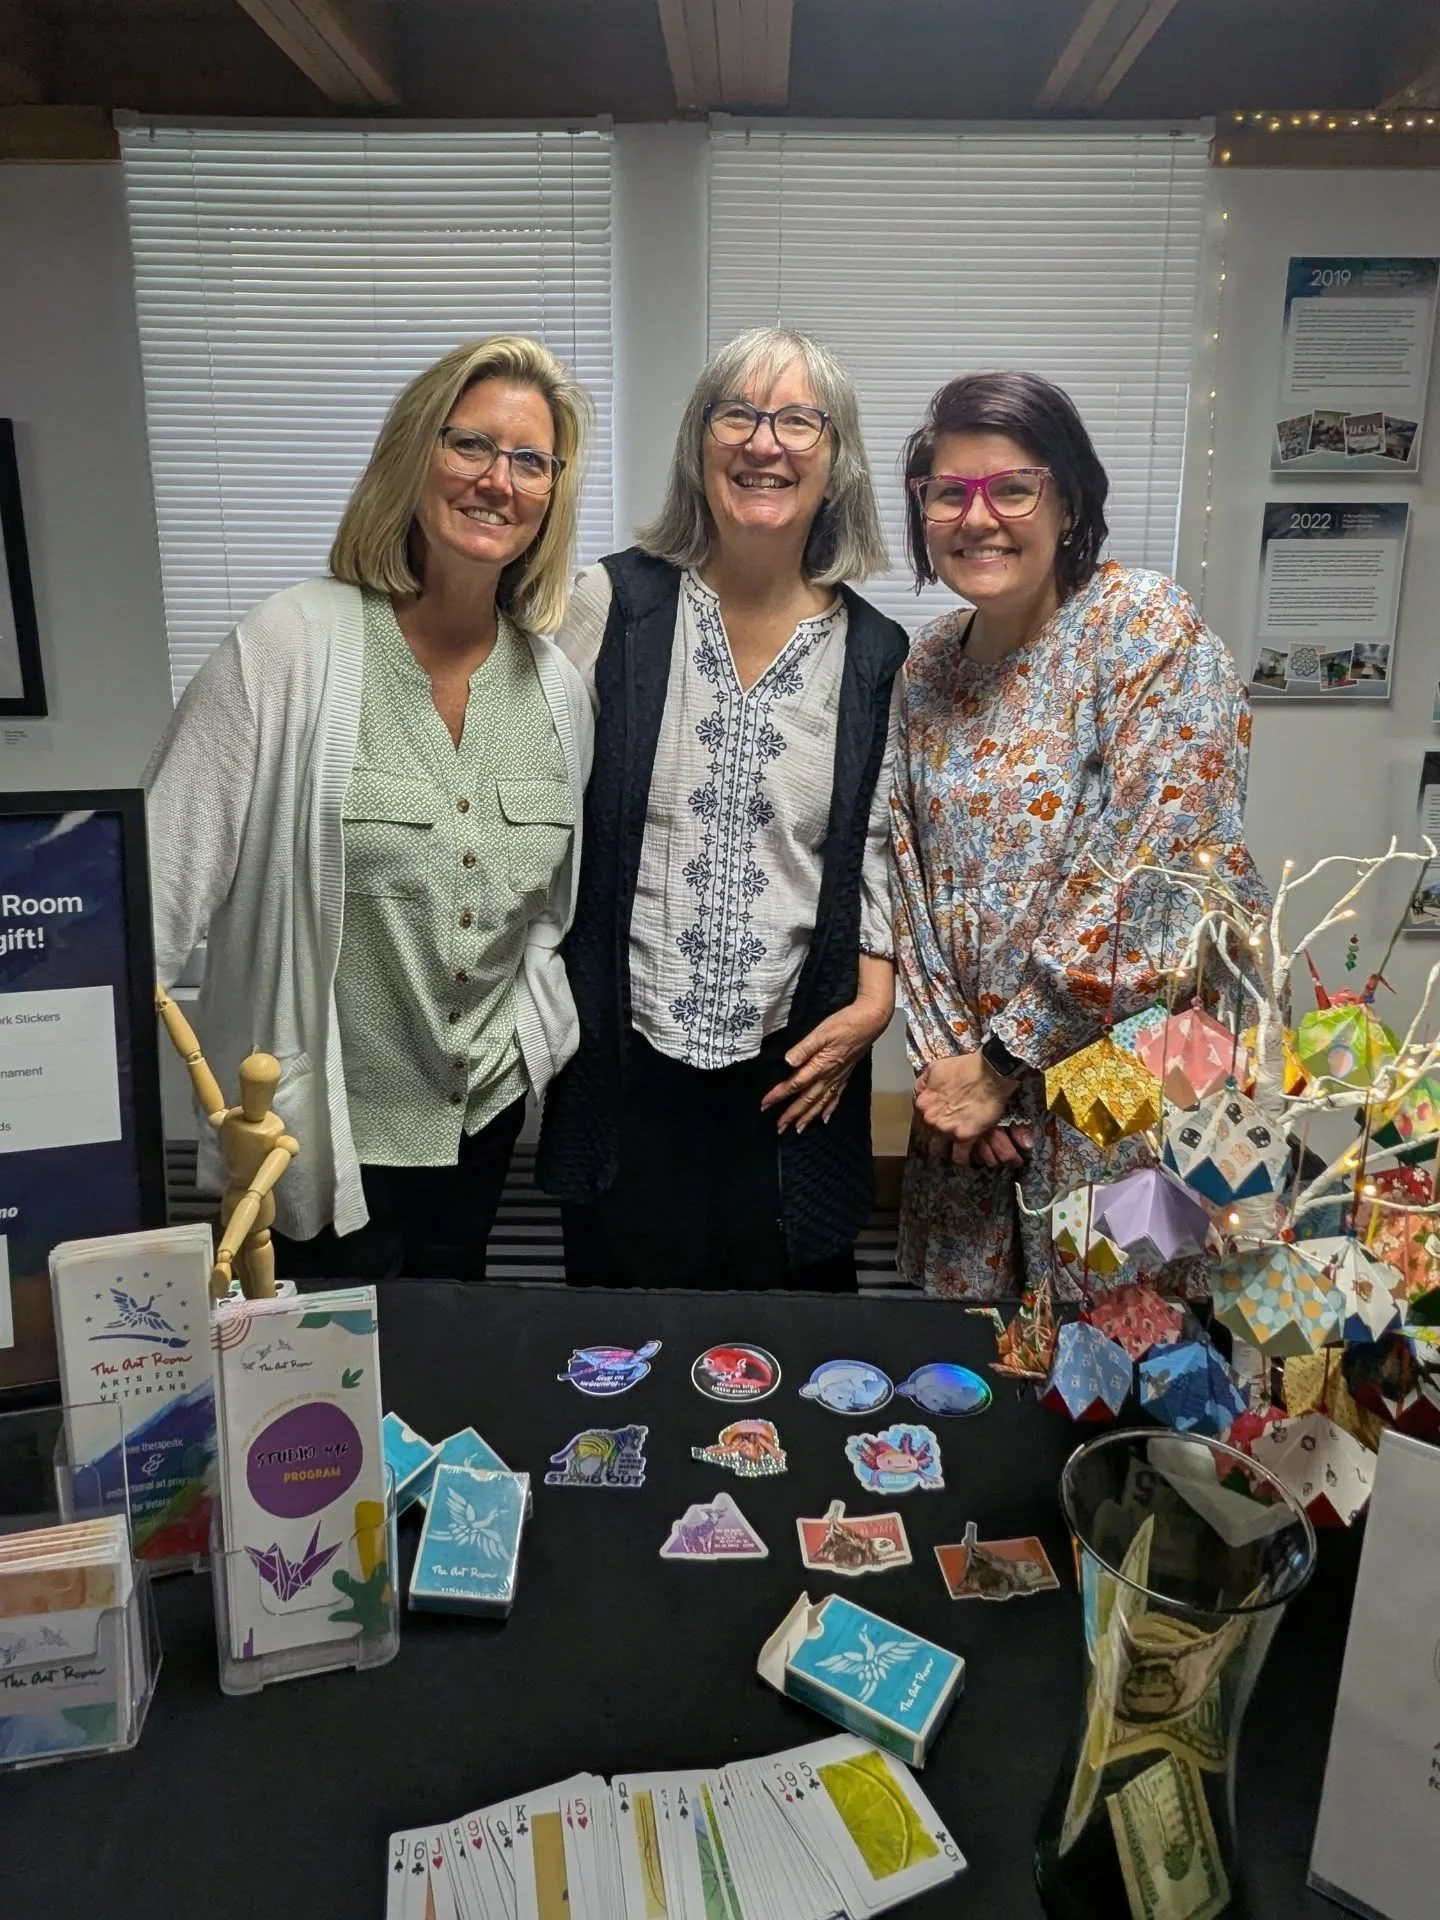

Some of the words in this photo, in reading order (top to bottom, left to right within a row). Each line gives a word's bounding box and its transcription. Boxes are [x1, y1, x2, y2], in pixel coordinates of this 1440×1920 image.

[1311, 269, 1352, 287] 2019
[1289, 513, 1331, 529] 2022
[2, 894, 83, 917] Room
[0, 927, 45, 956] gift!
[15, 1013, 61, 1024] Stickers
[90, 1361, 119, 1377] The
[121, 1355, 149, 1371] Art
[151, 1351, 193, 1367] Room
[258, 1362, 274, 1371] The
[100, 1374, 143, 1390] ARTS
[155, 1370, 185, 1380] FOR
[100, 1382, 187, 1402] VETERANS
[256, 1445, 318, 1469] STUDIO
[283, 1466, 341, 1484] PROGRAM
[606, 1474, 643, 1484] OUT
[431, 1564, 449, 1577] The
[449, 1566, 469, 1578] Art
[470, 1567, 498, 1579] Room
[1, 1671, 28, 1688] The
[31, 1668, 60, 1685] Art
[61, 1665, 106, 1681] Room
[899, 1697, 914, 1712] The
[908, 1680, 922, 1698] Art
[915, 1657, 934, 1682] Room
[799, 1761, 813, 1777] 5
[784, 1771, 798, 1787] 9
[677, 1786, 689, 1804] A
[515, 1805, 527, 1822] K
[575, 1798, 587, 1815] 5
[467, 1820, 479, 1836] 9
[496, 1820, 510, 1836] Q
[394, 1838, 406, 1857] J
[413, 1841, 425, 1860] 6
[944, 1843, 960, 1862] 5
